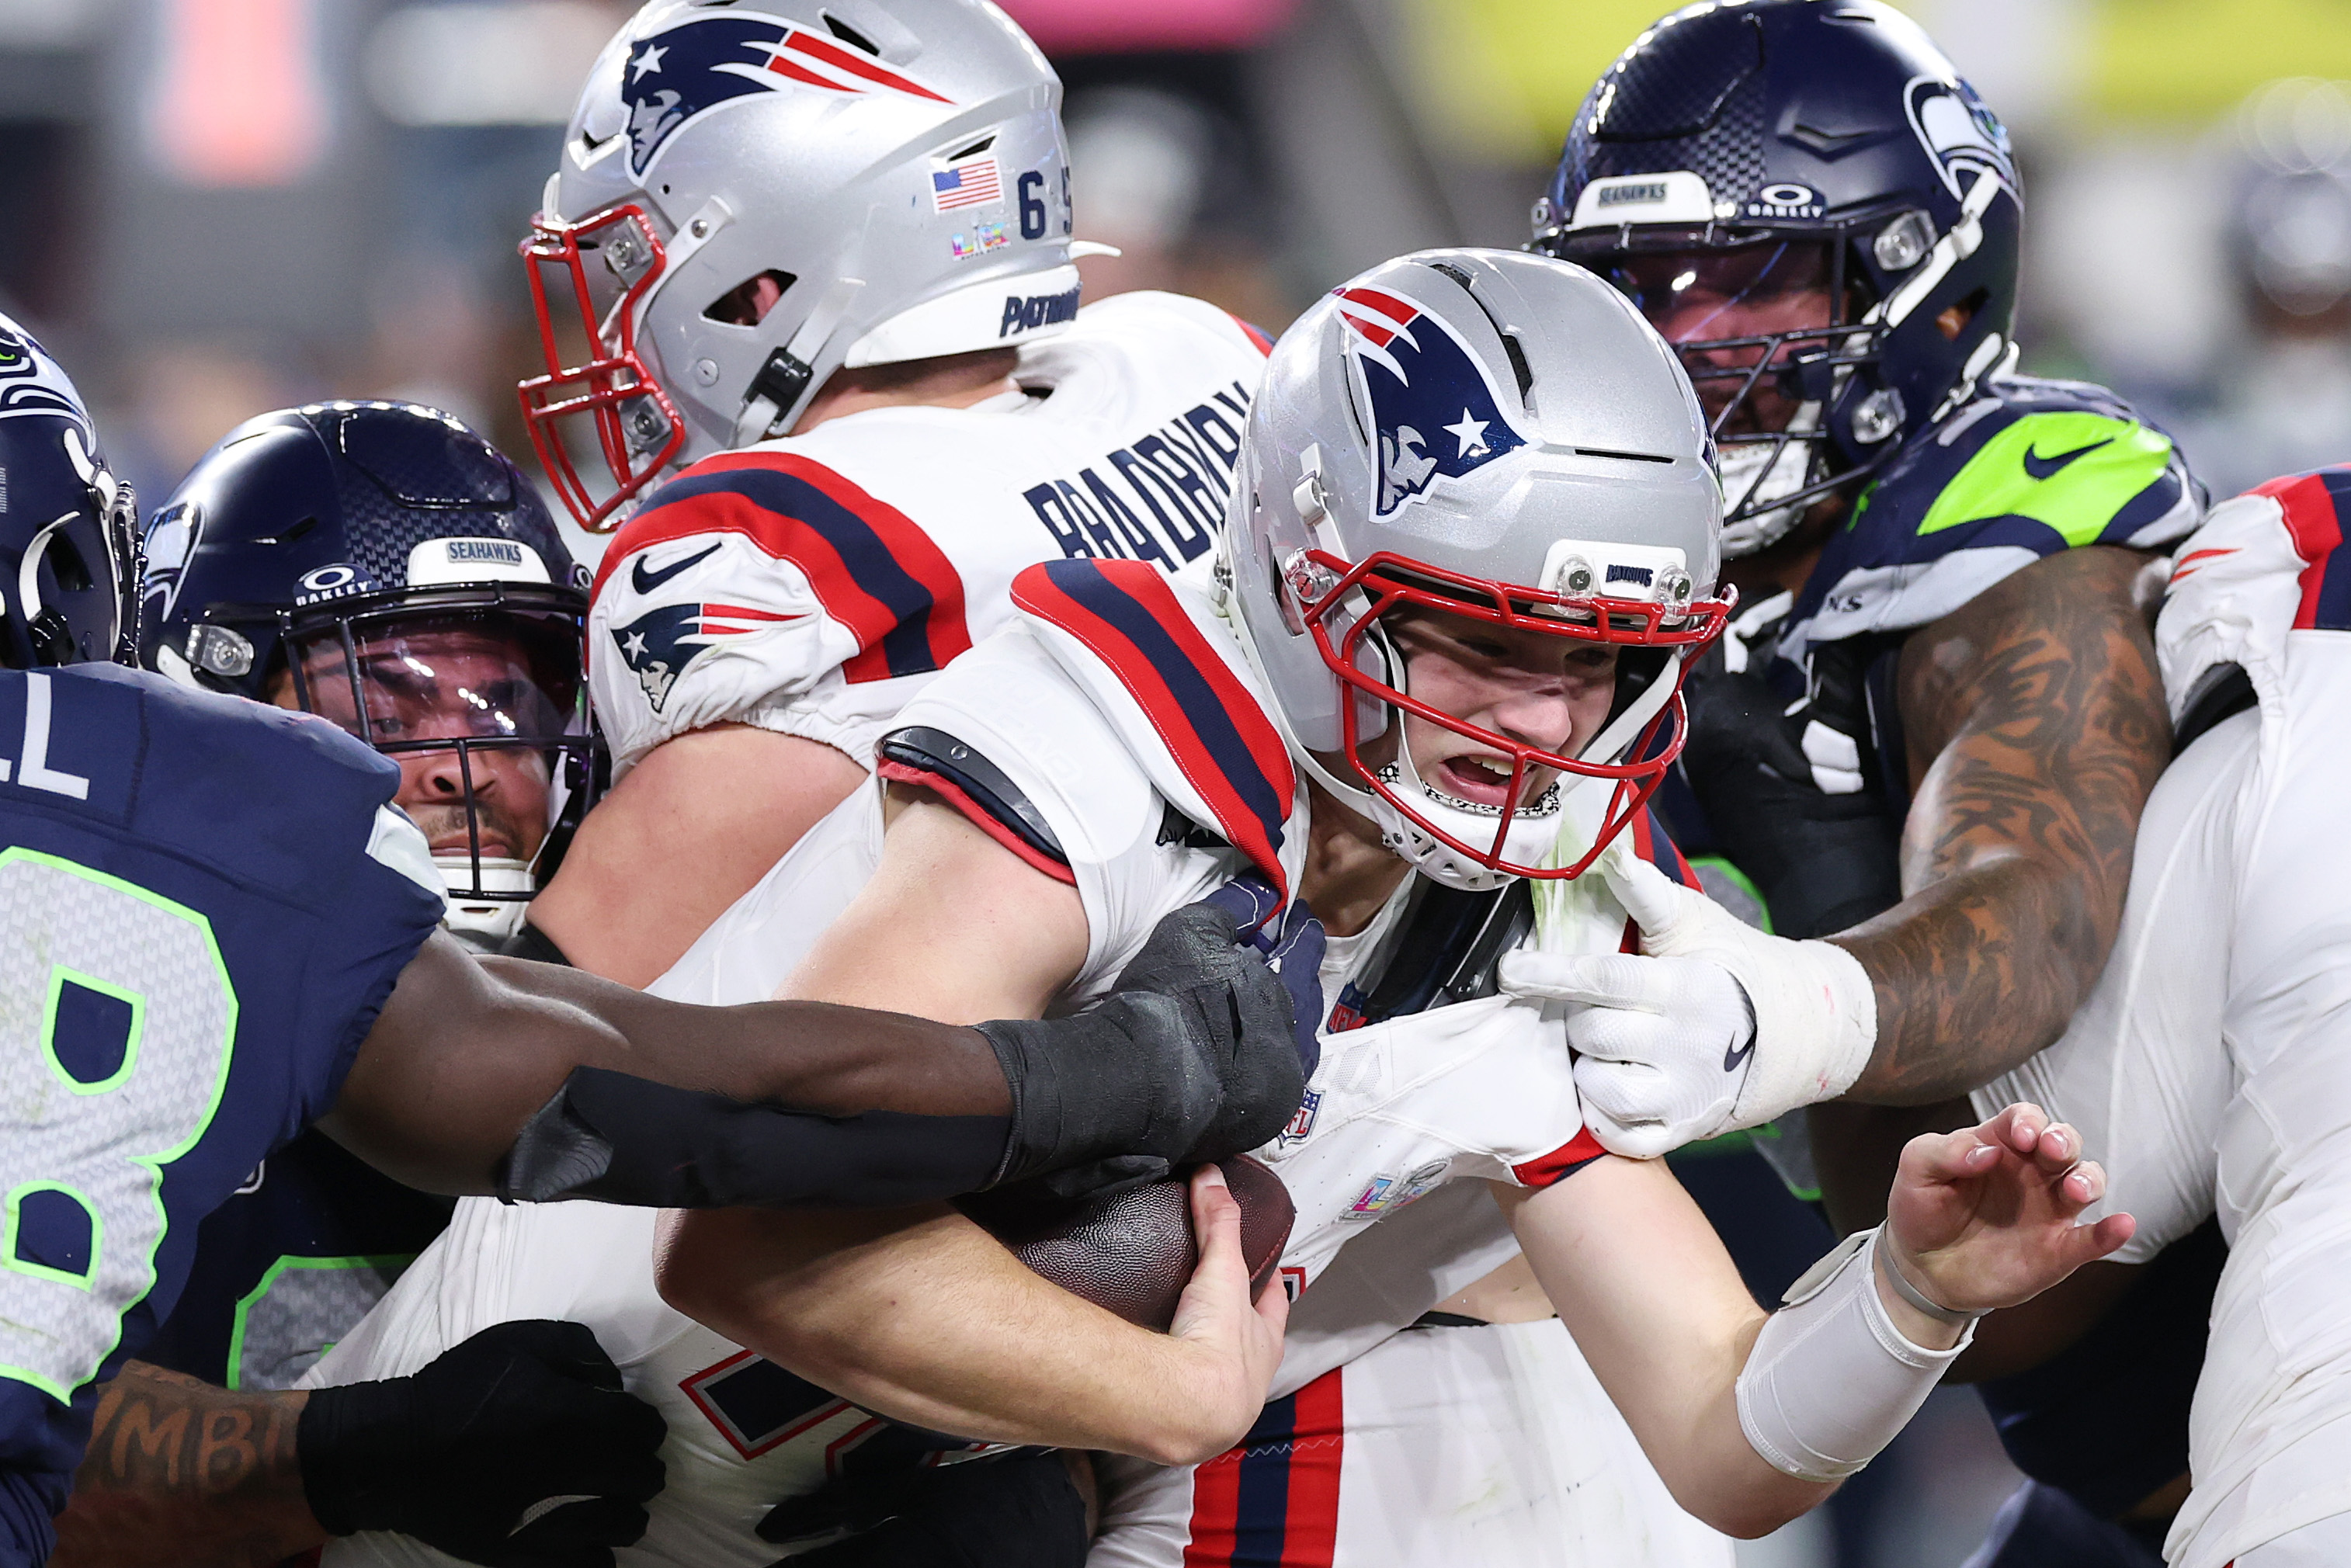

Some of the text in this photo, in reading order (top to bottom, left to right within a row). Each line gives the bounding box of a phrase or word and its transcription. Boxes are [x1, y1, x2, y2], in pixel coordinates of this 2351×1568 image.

[448, 542, 522, 564] SEAHAWKS
[1606, 564, 1654, 588] PATRIOTS
[296, 581, 370, 606] OAKLEY
[0, 671, 90, 800] L
